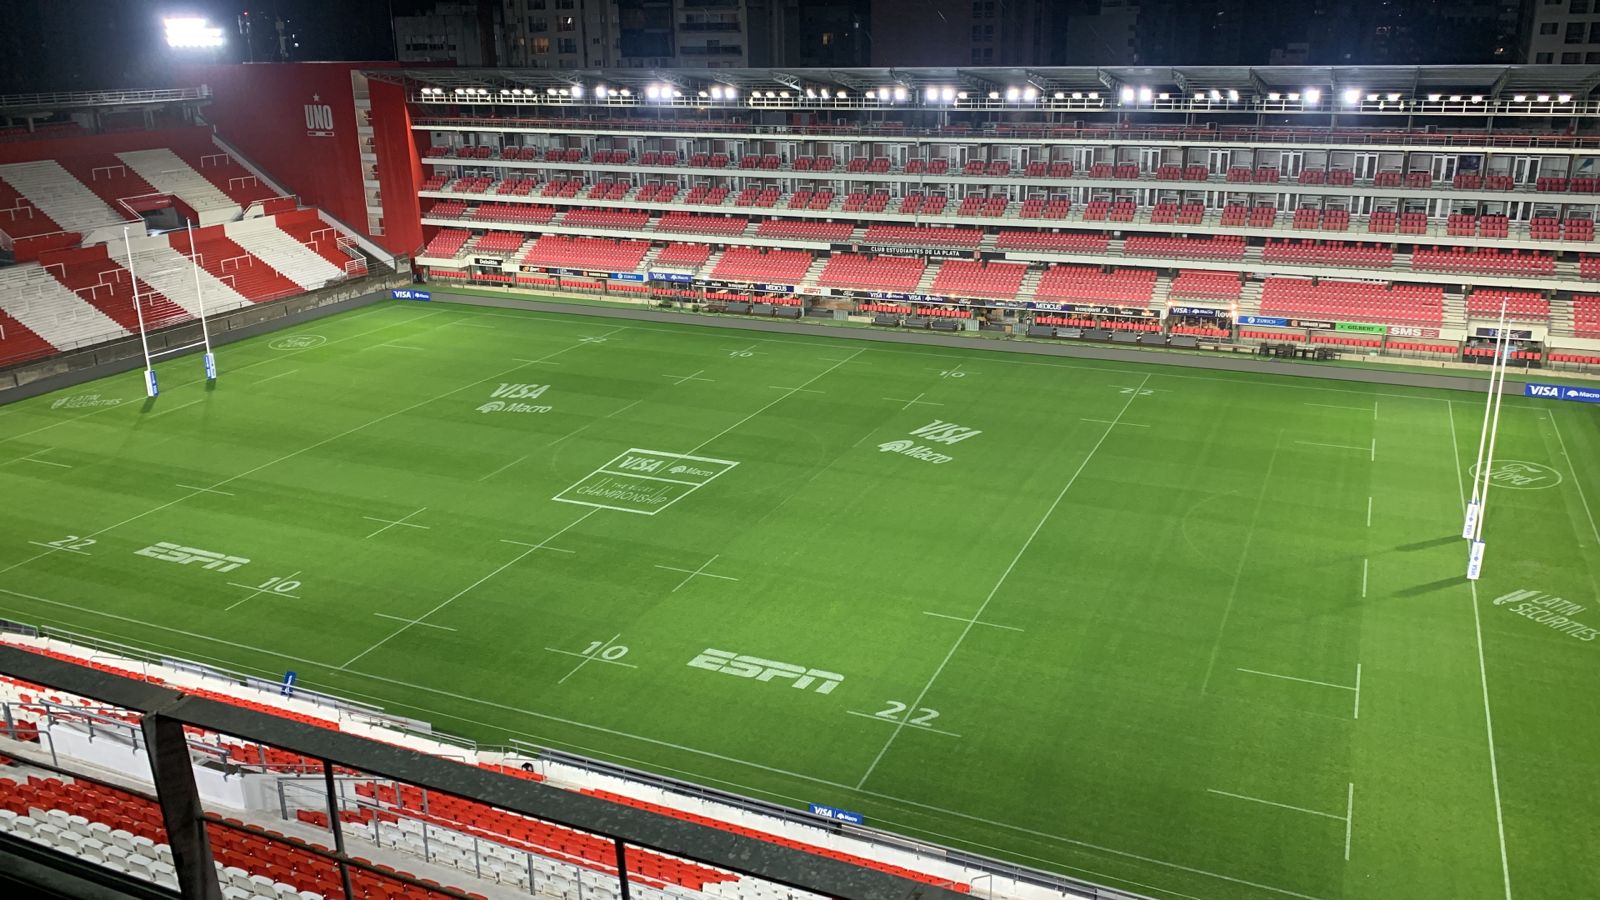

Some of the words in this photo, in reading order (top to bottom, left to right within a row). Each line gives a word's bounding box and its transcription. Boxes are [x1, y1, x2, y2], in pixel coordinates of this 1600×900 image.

[304, 104, 334, 130] UNO
[393, 290, 411, 299] VISA
[803, 287, 821, 295] ESPN
[1036, 303, 1062, 311] MEDICUS
[1390, 327, 1422, 336] SMS
[490, 383, 551, 399] VISA
[1529, 385, 1558, 397] VISA
[1578, 391, 1600, 399] Macro
[502, 403, 553, 413] Macro
[908, 419, 982, 445] VISA
[901, 445, 953, 464] Macro
[618, 456, 665, 472] VISA
[684, 467, 714, 477] Macro
[576, 486, 668, 504] CHAMPIONSHIP
[49, 535, 97, 550] 22
[133, 541, 251, 573] ESPN
[258, 577, 302, 592] 10
[1531, 594, 1587, 616] LATIN
[1509, 603, 1600, 641] SECURITIES
[581, 640, 630, 661] 10
[686, 648, 845, 695] ESPN
[875, 700, 940, 727] 22
[813, 806, 832, 818] VISA
